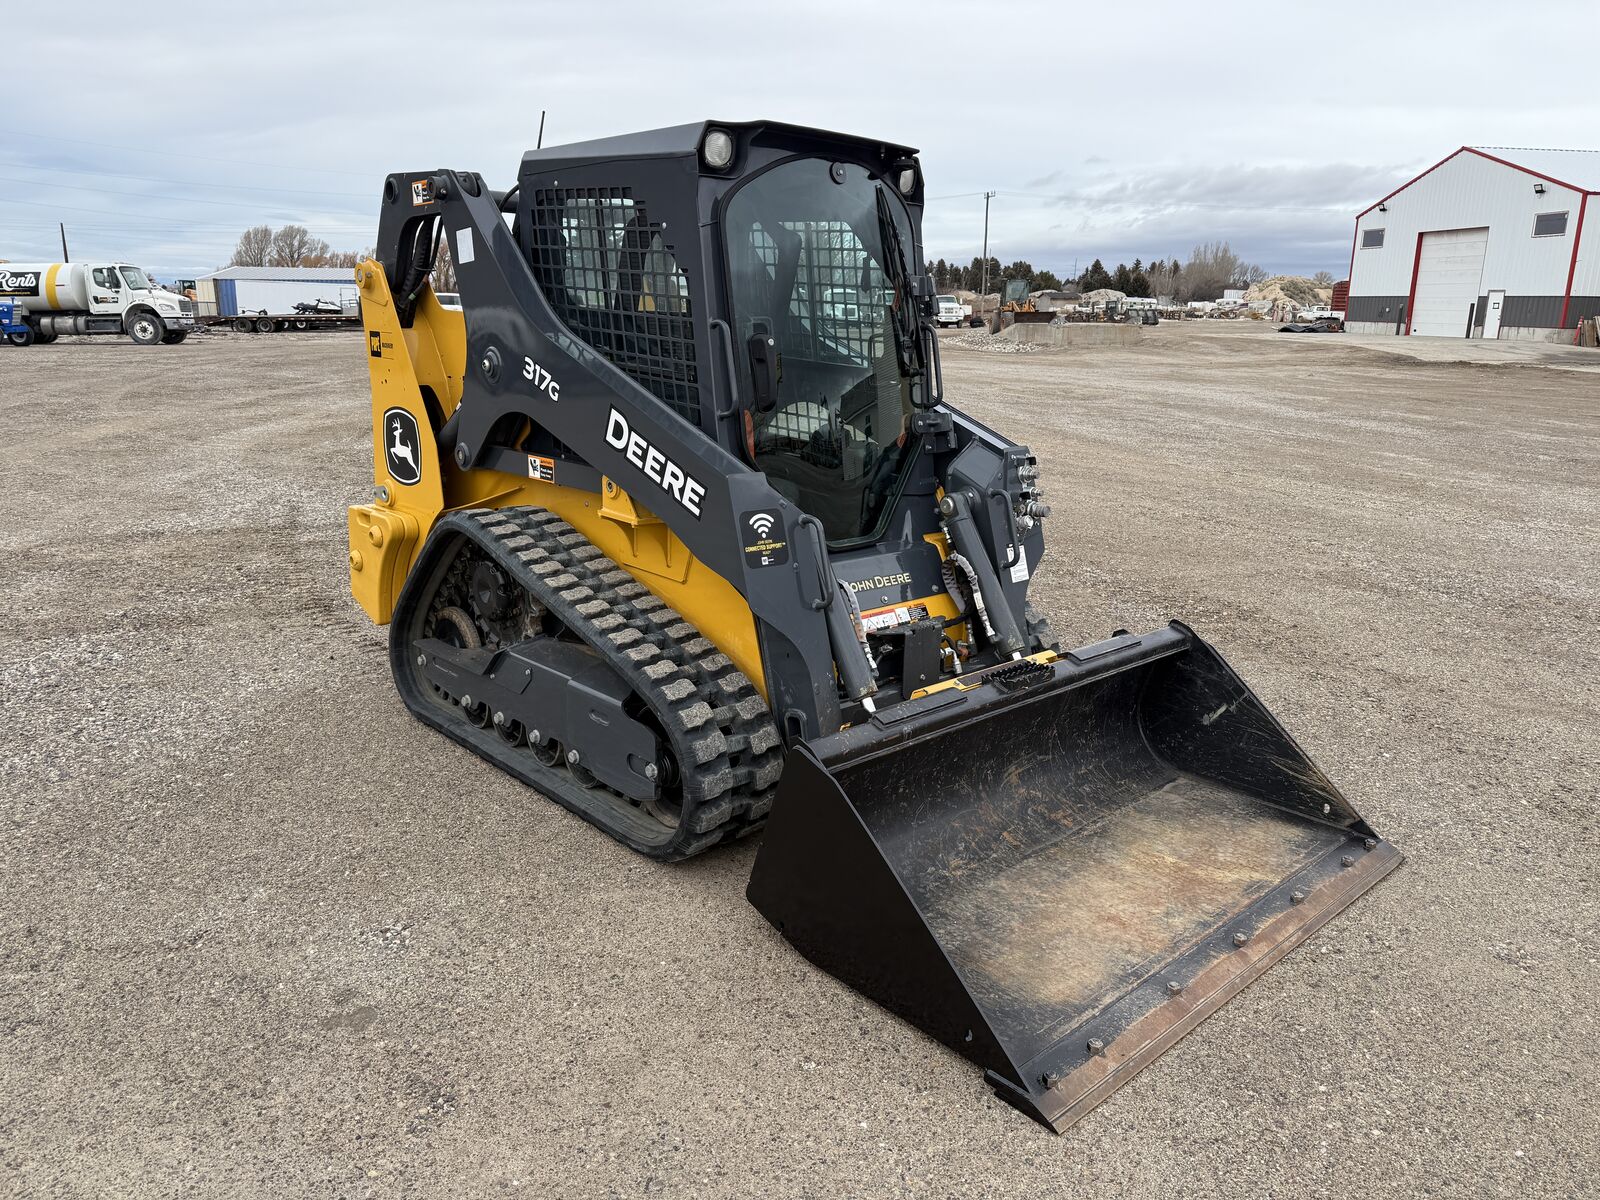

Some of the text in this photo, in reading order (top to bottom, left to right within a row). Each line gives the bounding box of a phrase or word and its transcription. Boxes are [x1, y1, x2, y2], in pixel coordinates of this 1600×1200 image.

[0, 270, 36, 291] Rents
[522, 356, 560, 402] 317G
[605, 407, 706, 517] DEERE
[849, 573, 912, 592] OHN DEERE
